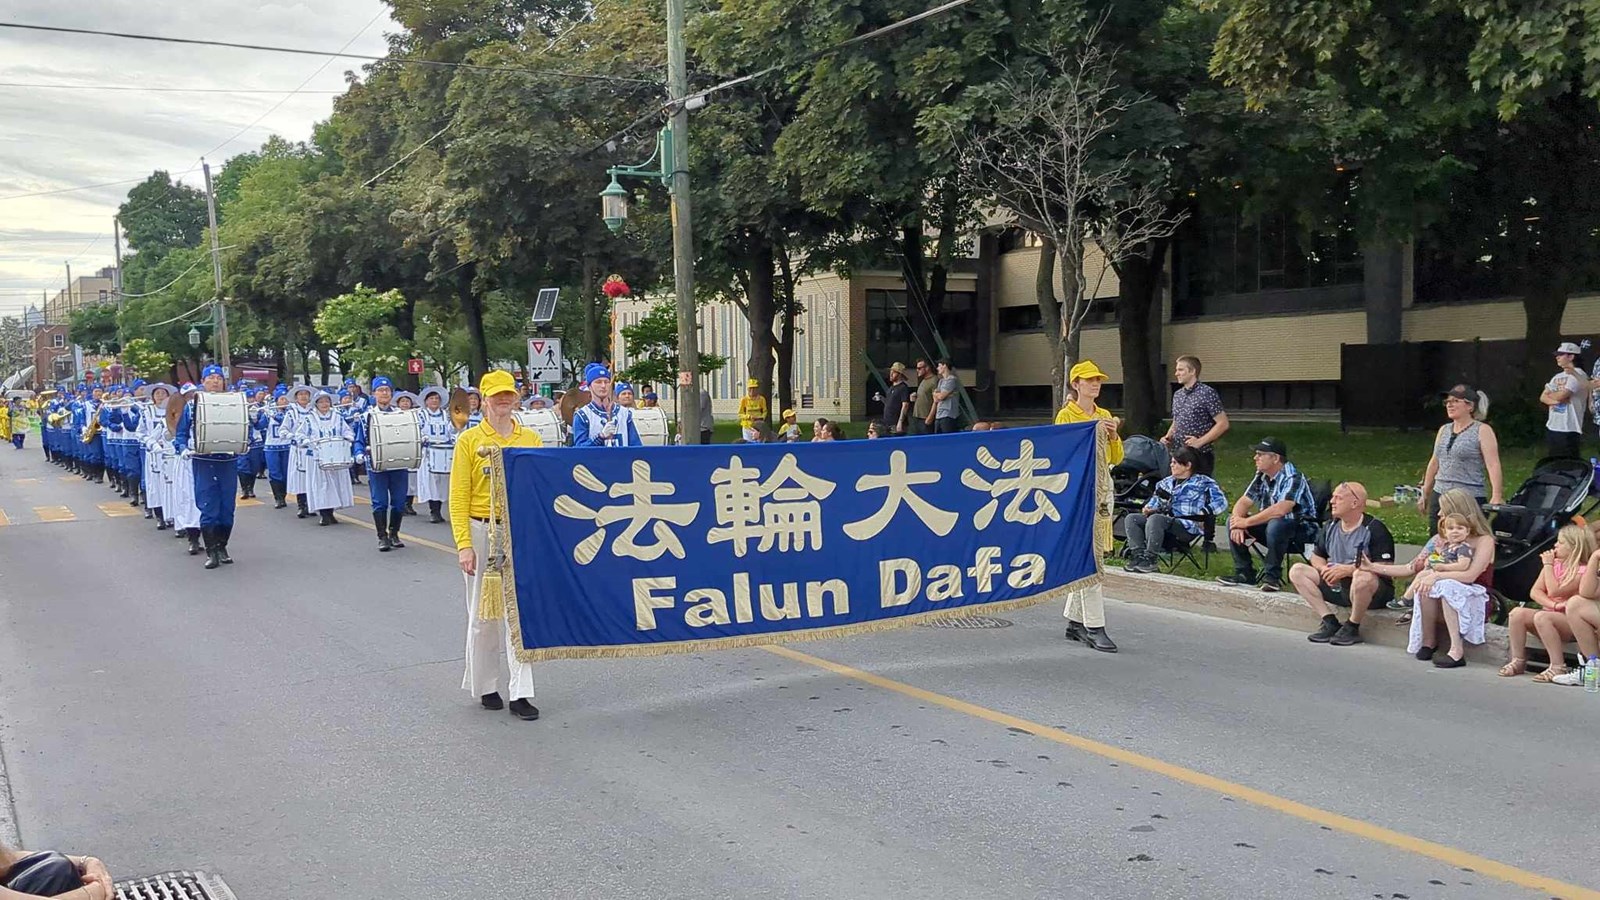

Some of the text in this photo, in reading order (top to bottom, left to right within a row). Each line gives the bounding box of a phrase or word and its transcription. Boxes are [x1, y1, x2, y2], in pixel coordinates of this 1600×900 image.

[553, 439, 1070, 565] 法輪大法
[631, 546, 1047, 631] Falun Dafa
